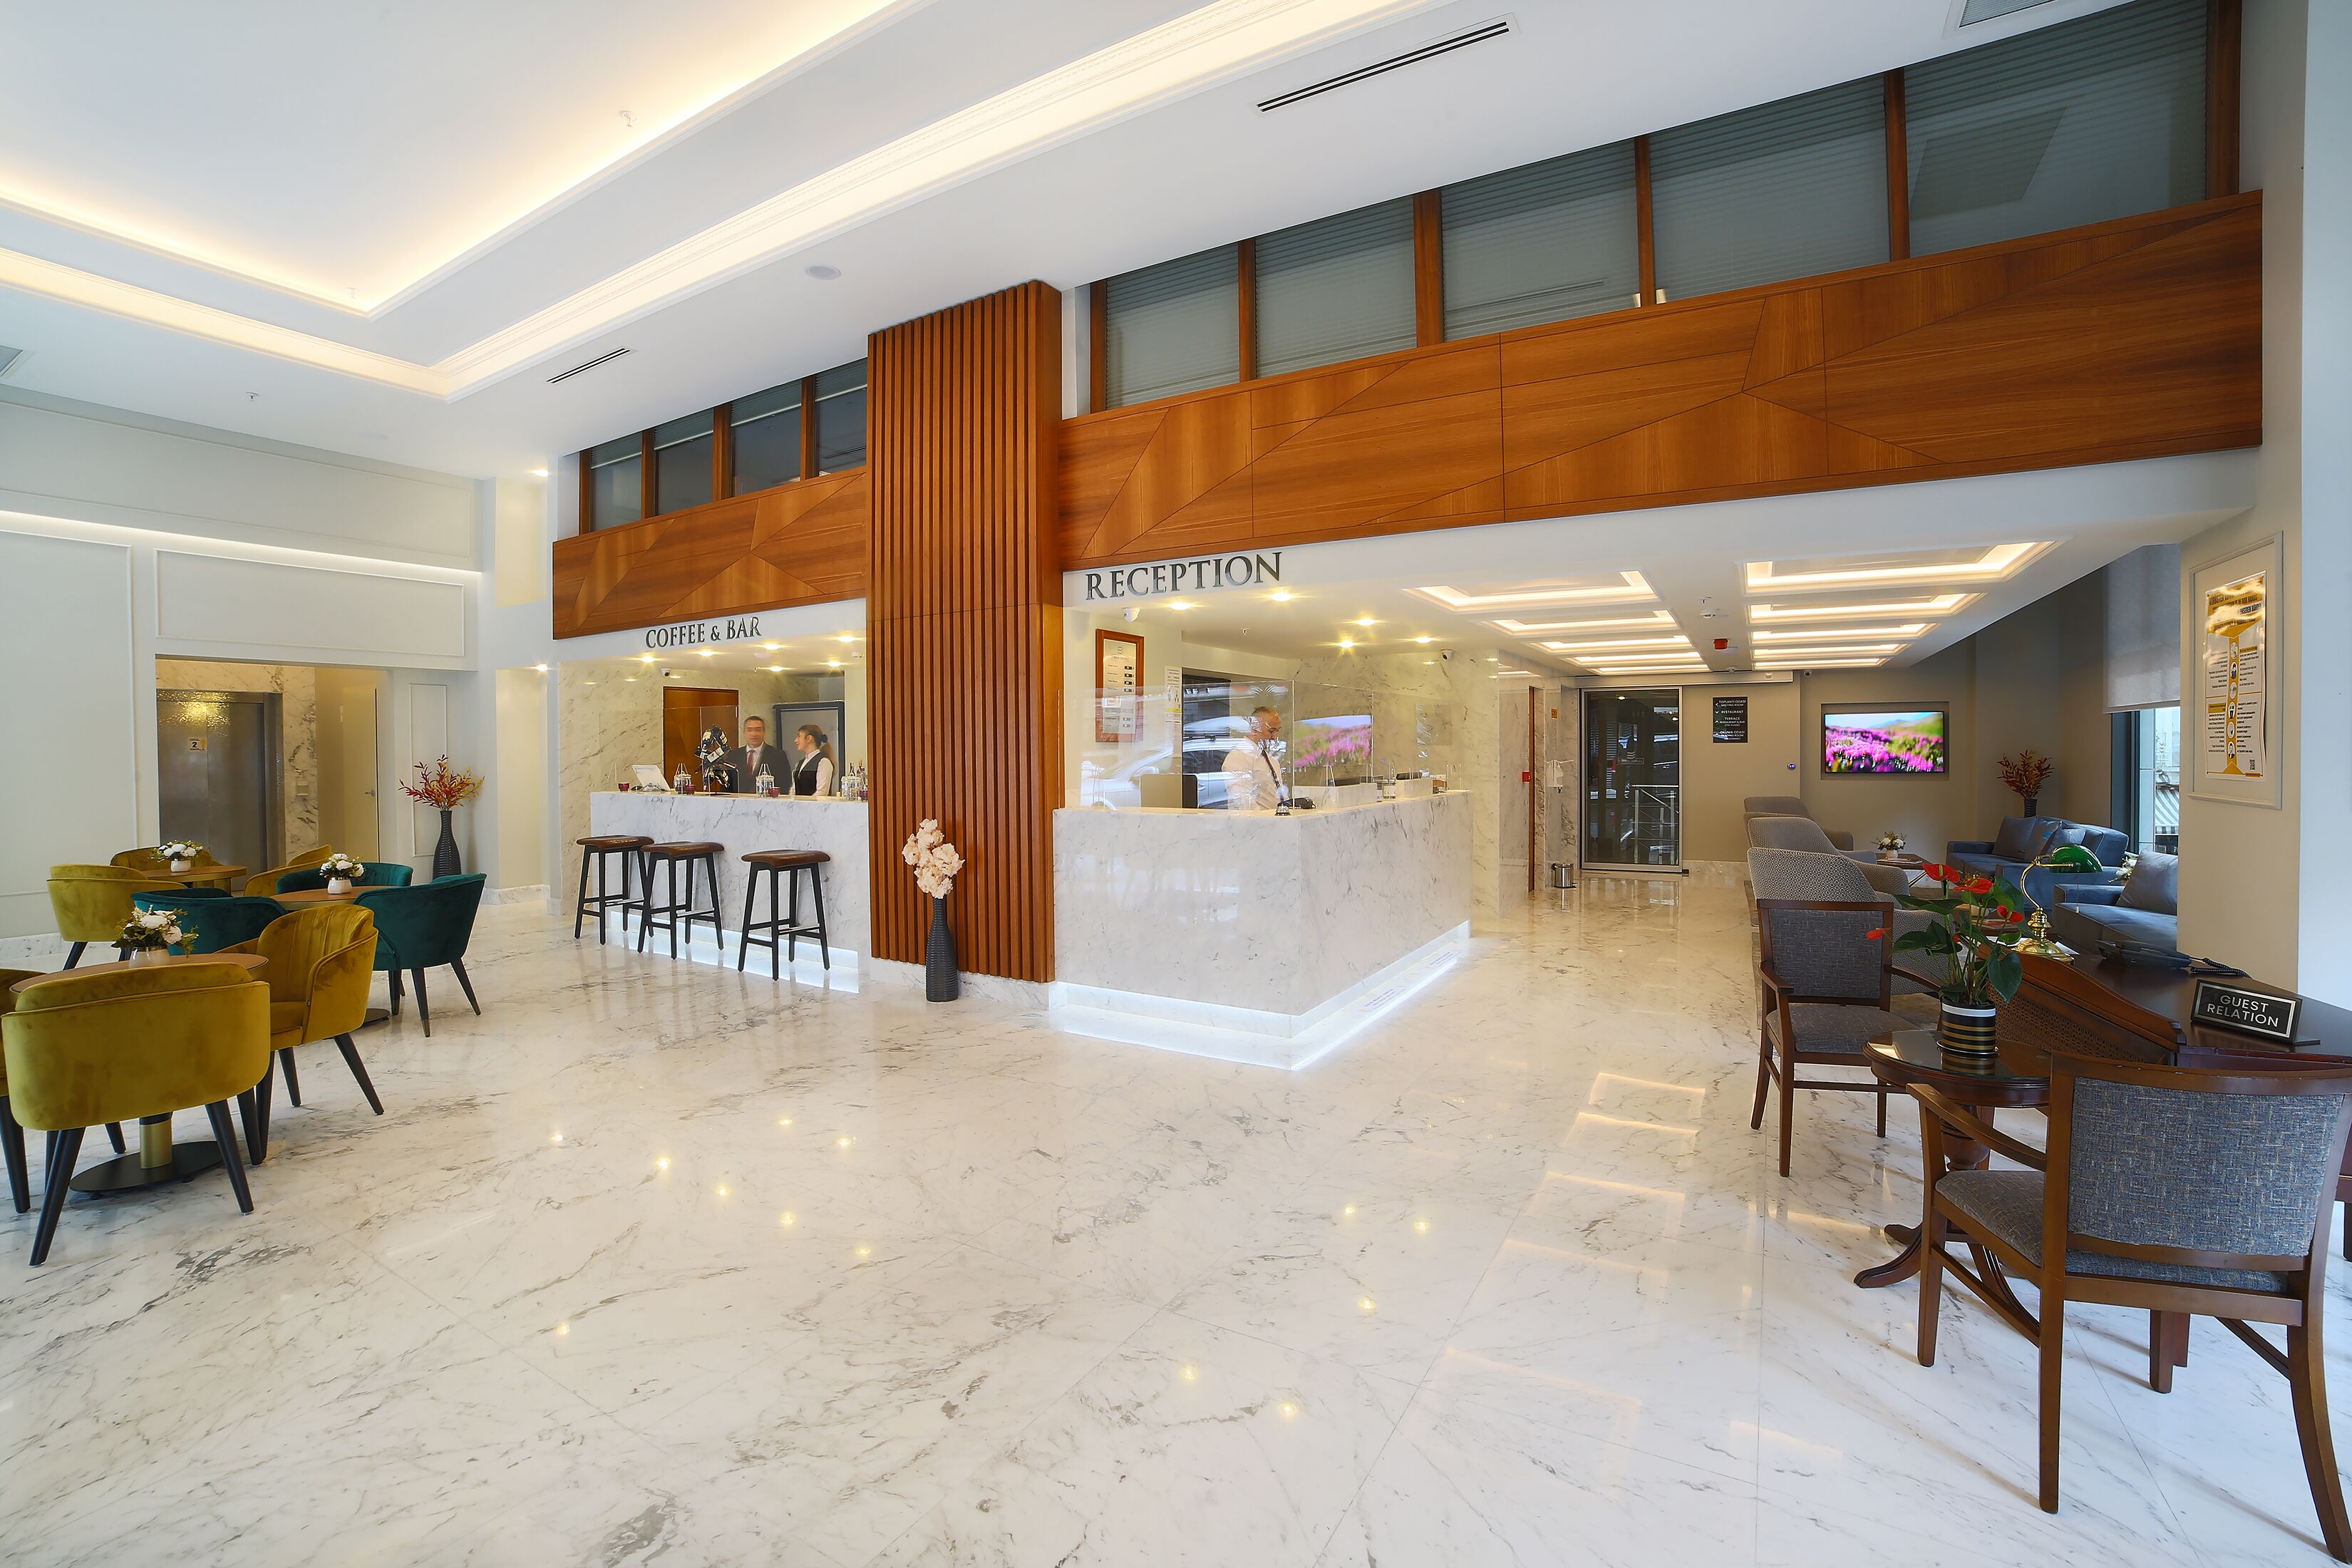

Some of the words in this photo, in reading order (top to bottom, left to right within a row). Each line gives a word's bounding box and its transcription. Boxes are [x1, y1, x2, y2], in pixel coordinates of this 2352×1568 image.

[1085, 552, 1282, 600] RECEPTION
[646, 623, 705, 648] COFFEE
[710, 625, 721, 641] &
[726, 617, 762, 639] BAR
[2207, 1003, 2279, 1027] RELATION
[2220, 995, 2269, 1012] GUEST
